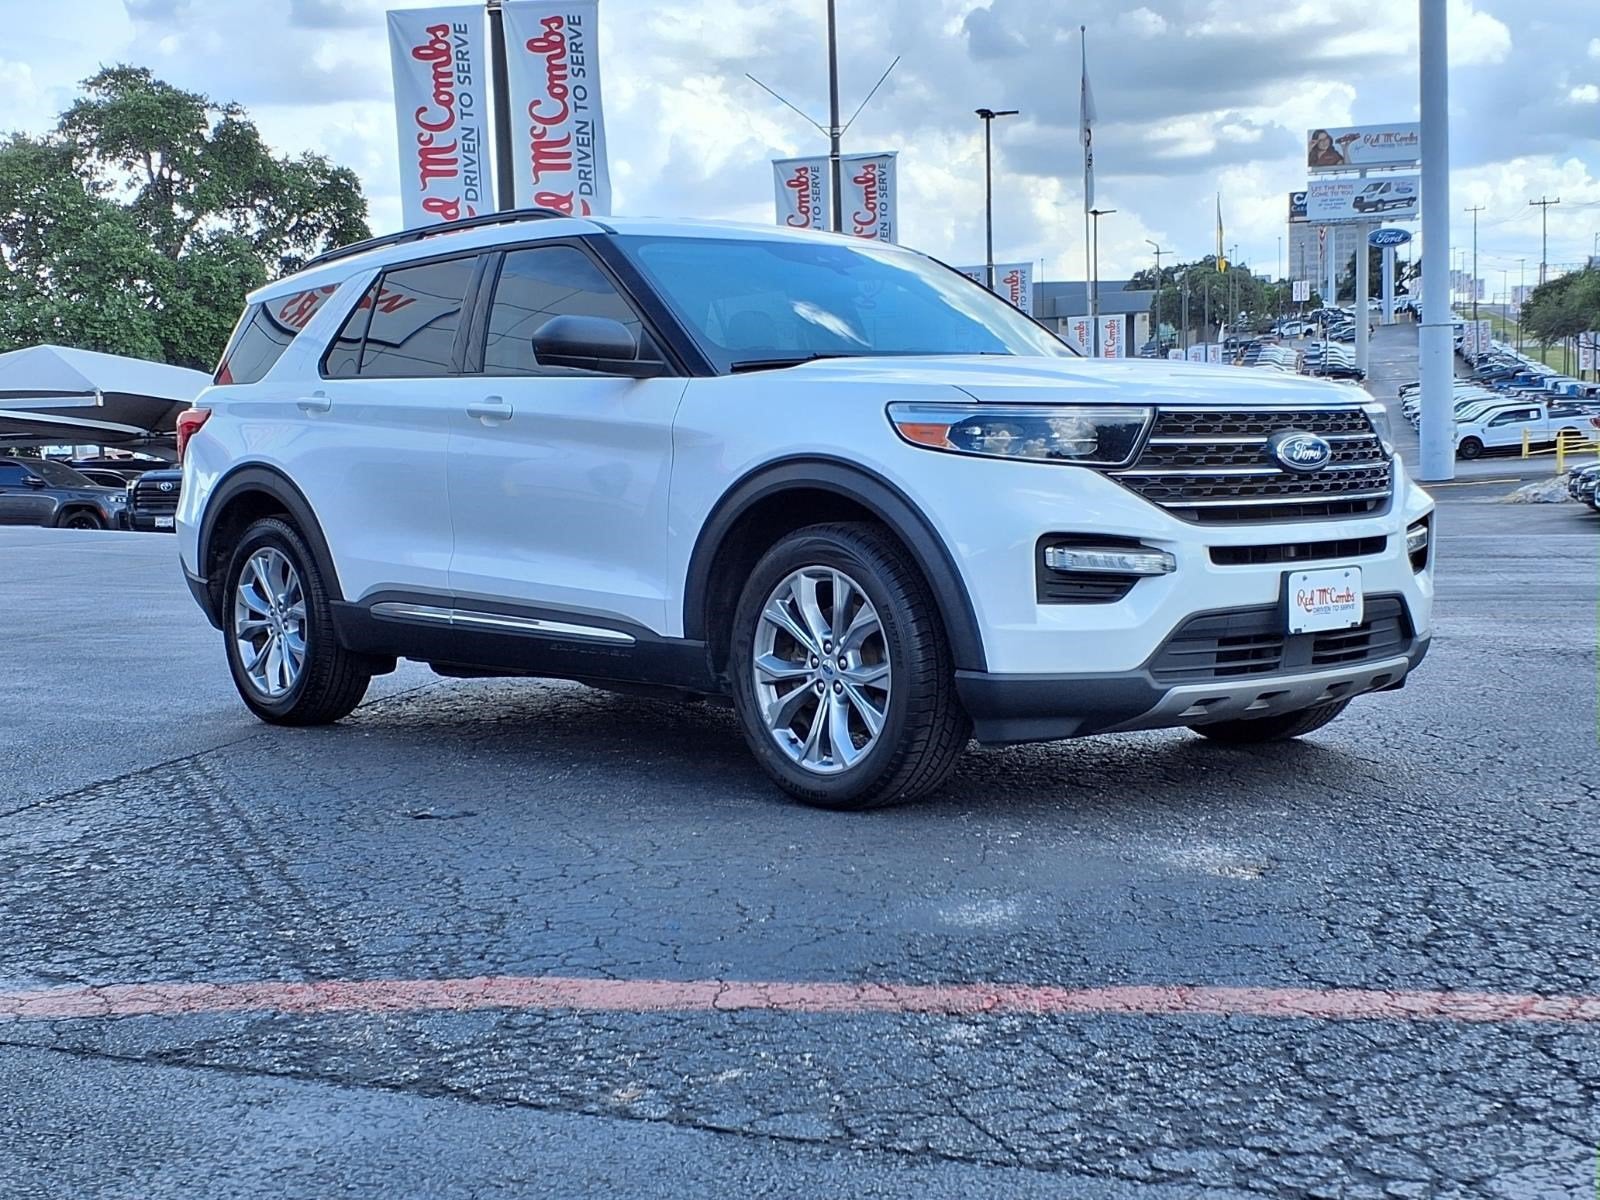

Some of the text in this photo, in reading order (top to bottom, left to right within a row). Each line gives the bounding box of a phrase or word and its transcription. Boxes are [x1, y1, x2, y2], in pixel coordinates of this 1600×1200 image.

[453, 23, 472, 85] SERVE
[567, 15, 586, 78] SERVE
[412, 24, 458, 191] McCombs
[459, 92, 474, 120] TO
[526, 15, 572, 185] McCombs
[572, 84, 588, 112] TO
[462, 127, 478, 202] DRIVEN
[575, 120, 593, 196] DRIVEN
[810, 165, 821, 202] SERVE
[878, 163, 888, 198] SERVE
[813, 207, 822, 222] TO
[880, 204, 888, 220] TO
[1376, 232, 1402, 243] Ford
[1292, 441, 1321, 460] Ford
[1297, 586, 1354, 612] Red McCombs
